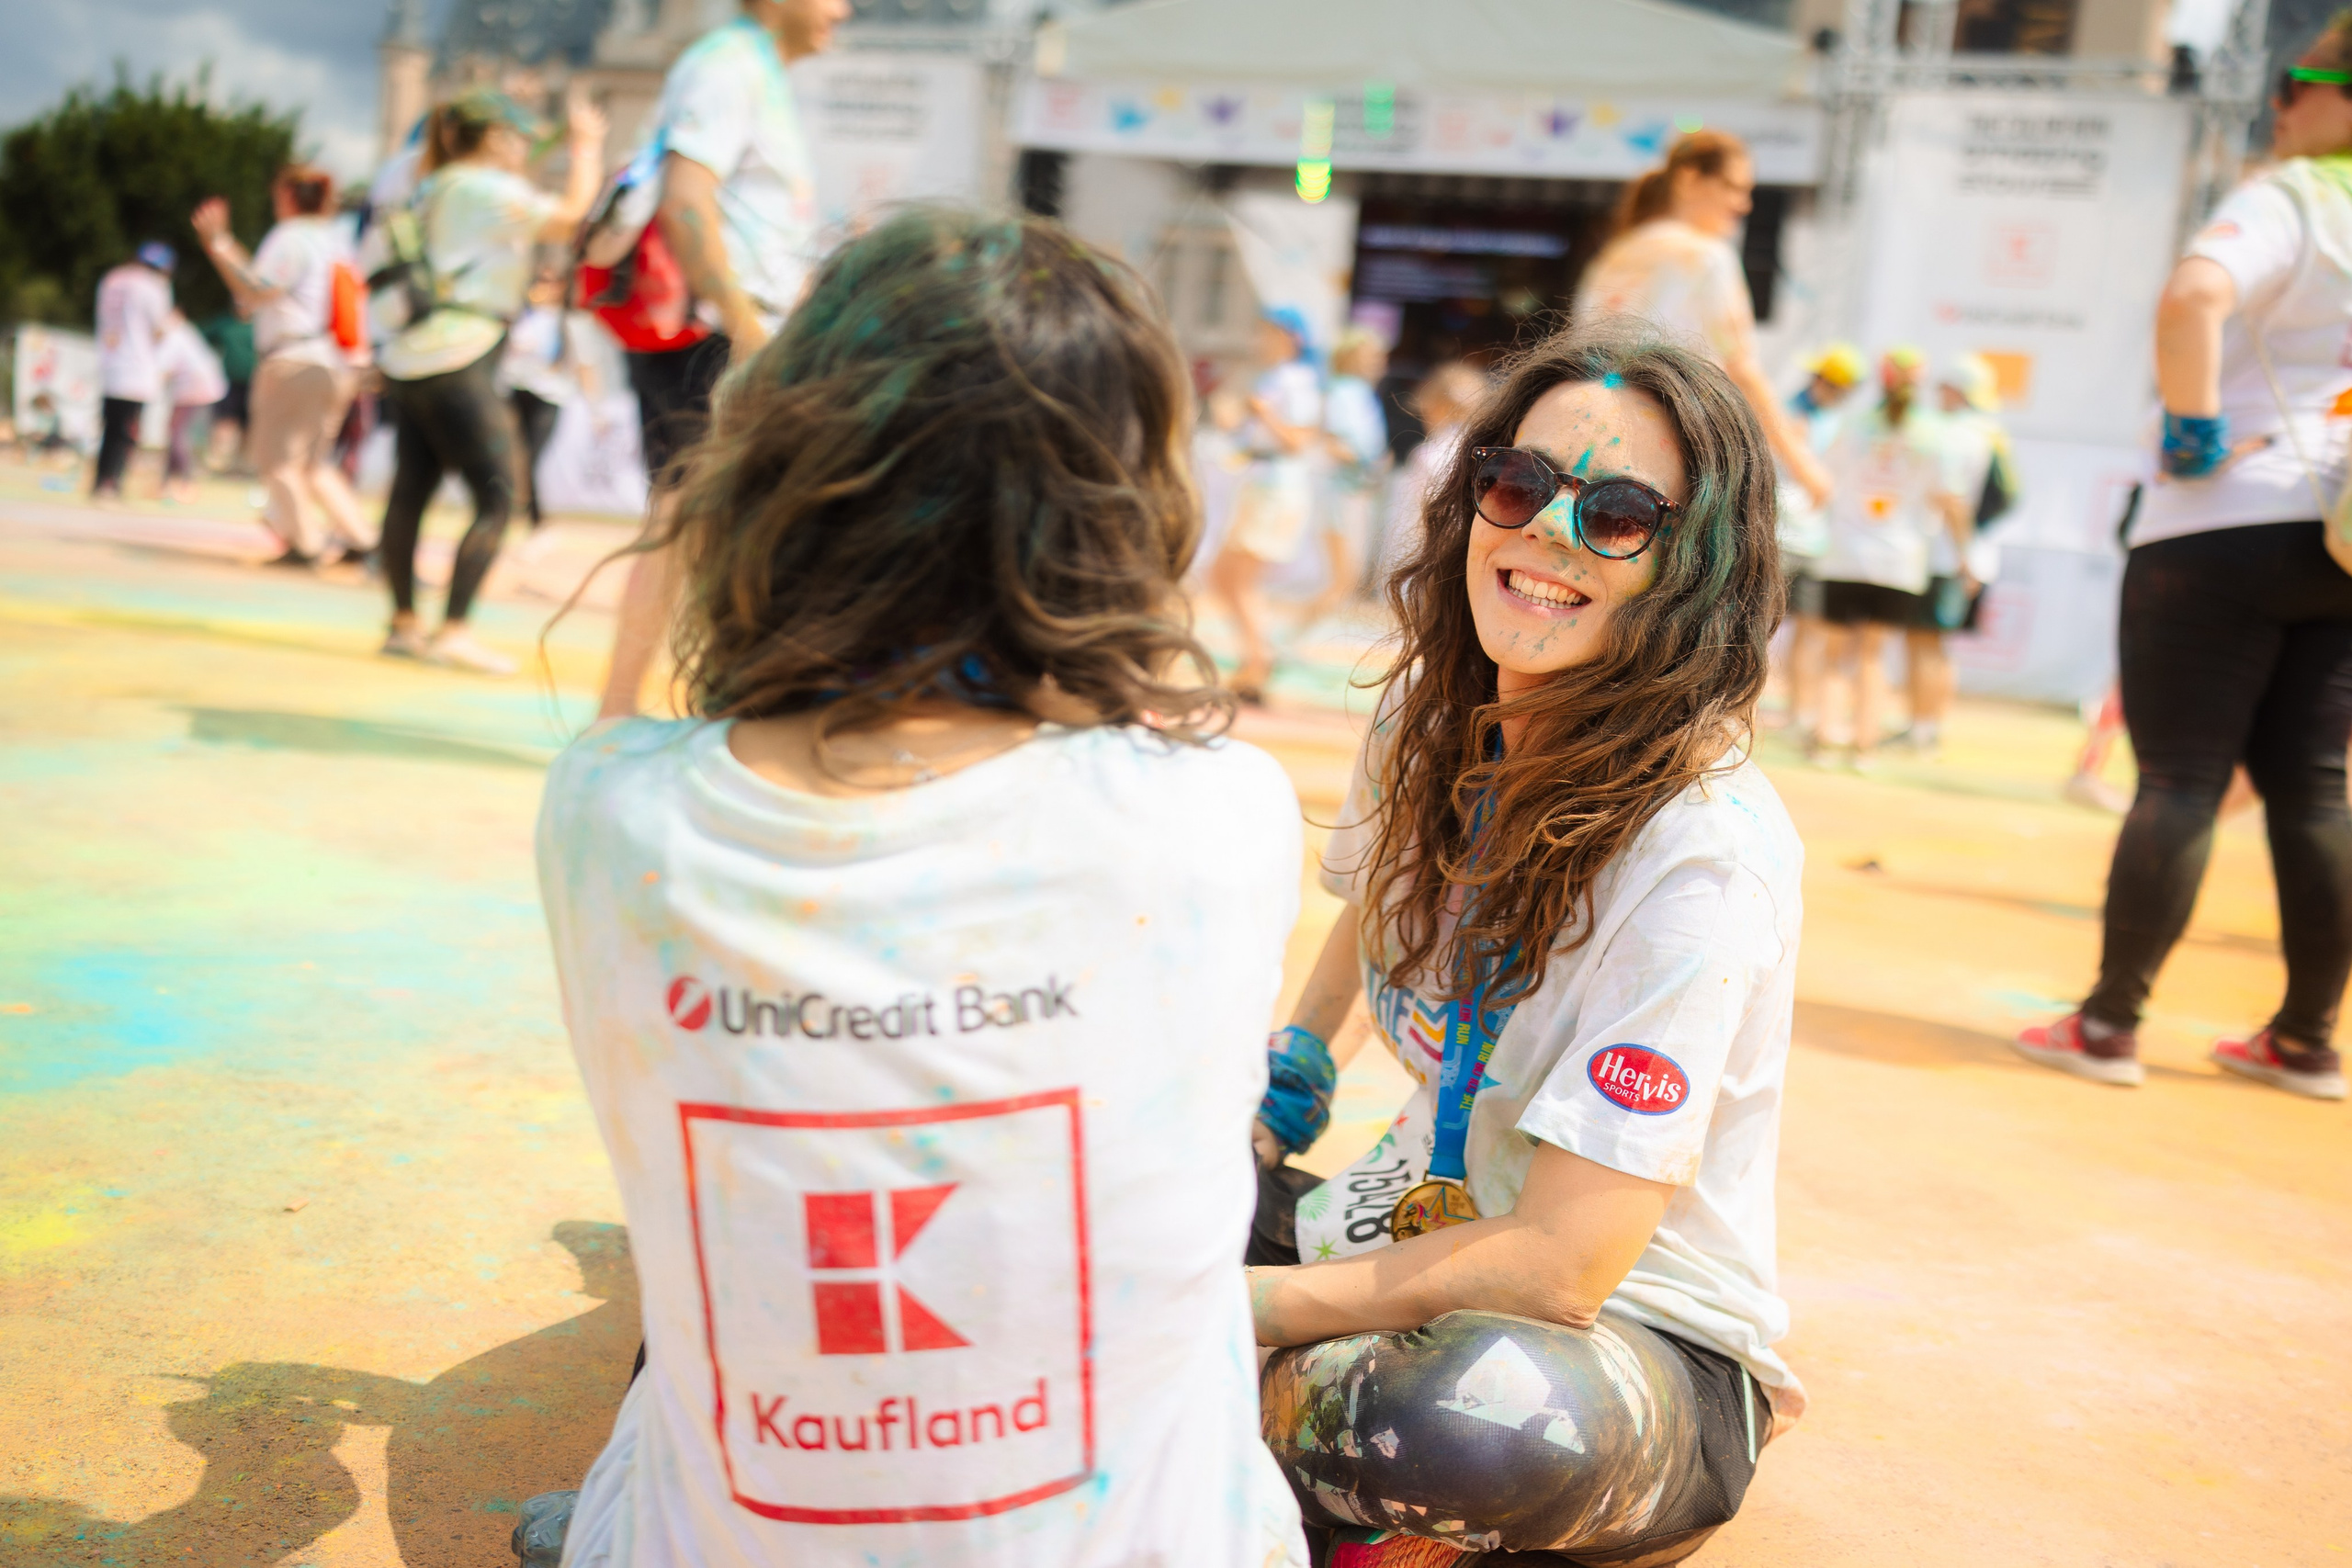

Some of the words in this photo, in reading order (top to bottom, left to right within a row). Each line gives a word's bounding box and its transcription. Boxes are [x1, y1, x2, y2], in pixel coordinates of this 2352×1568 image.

[719, 987, 936, 1040] UniCredit
[955, 975, 1079, 1033] Bank
[1455, 1021, 1471, 1045] RUN
[1477, 1041, 1497, 1064] RUN
[1599, 1052, 1682, 1103] Hervis
[1603, 1082, 1641, 1102] SPORTS
[749, 1376, 1049, 1451] Kaufland
